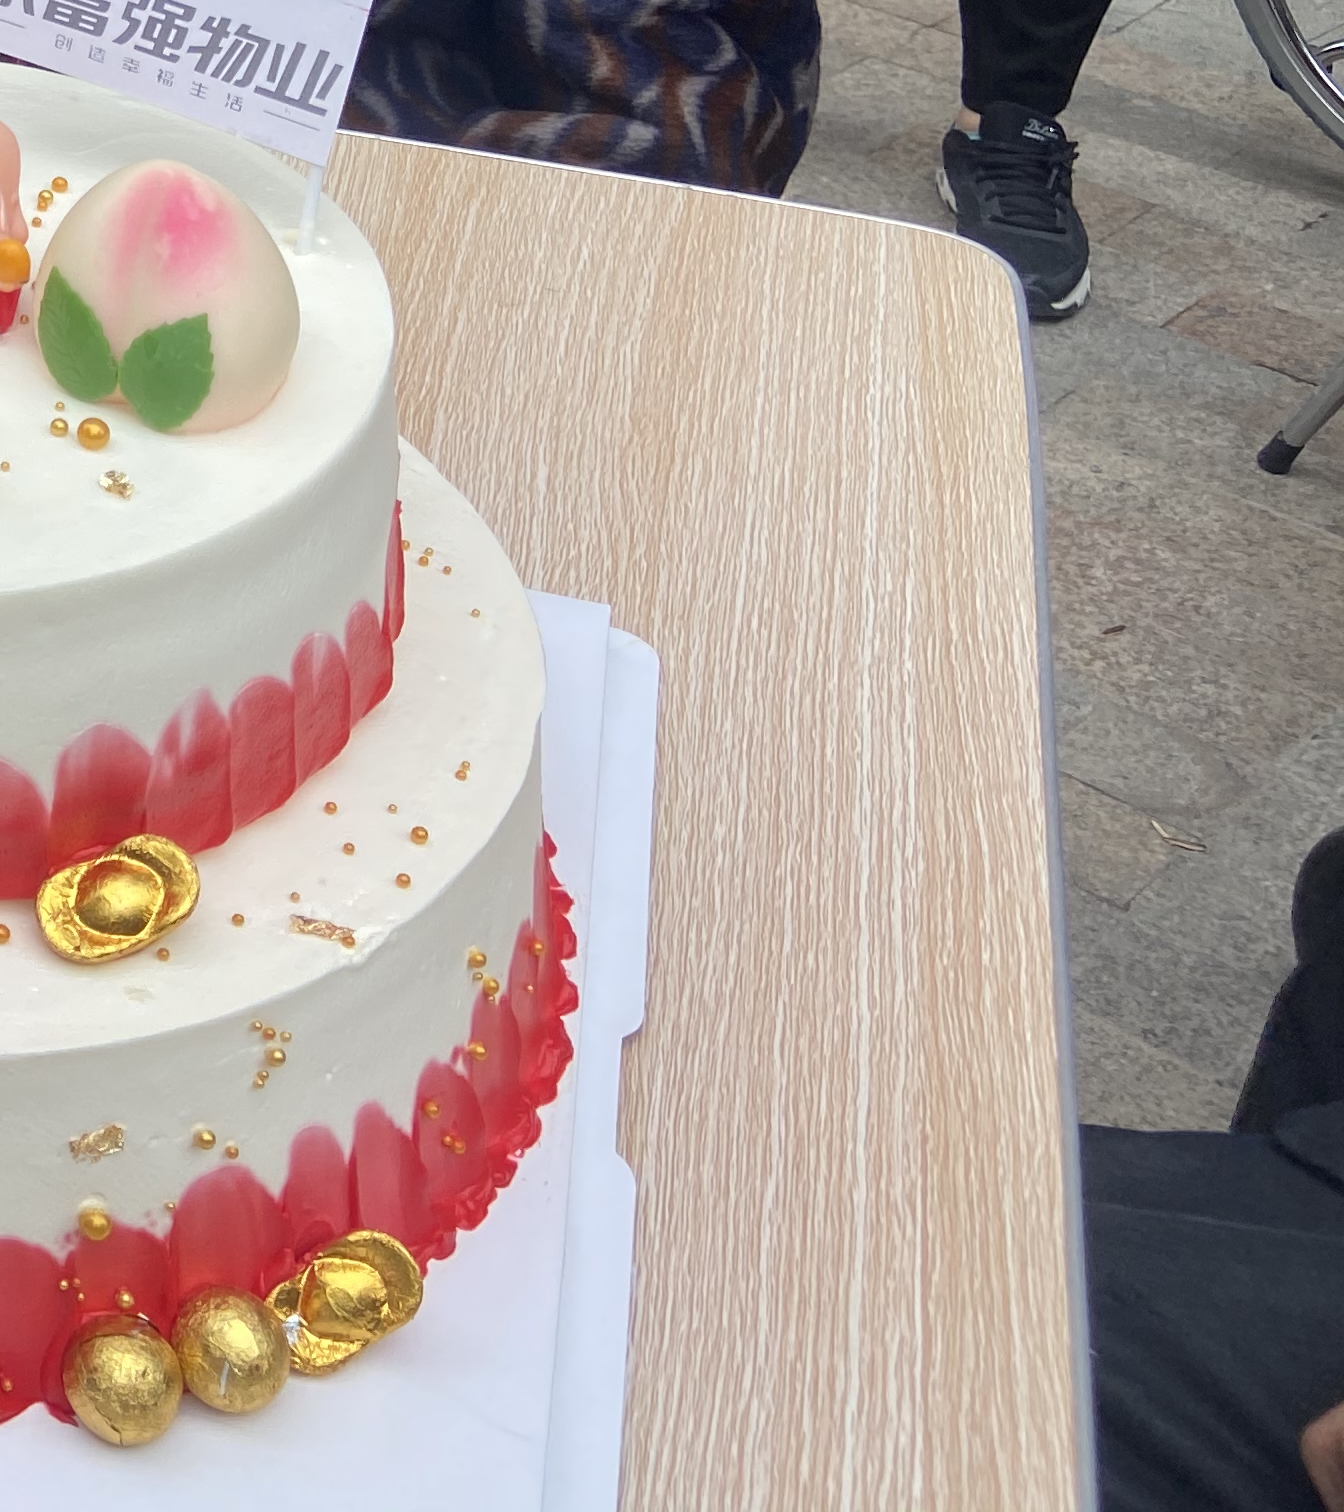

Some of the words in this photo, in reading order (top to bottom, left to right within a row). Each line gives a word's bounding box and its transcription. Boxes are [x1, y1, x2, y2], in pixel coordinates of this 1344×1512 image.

[53, 33, 244, 113] 创造幸福生活
